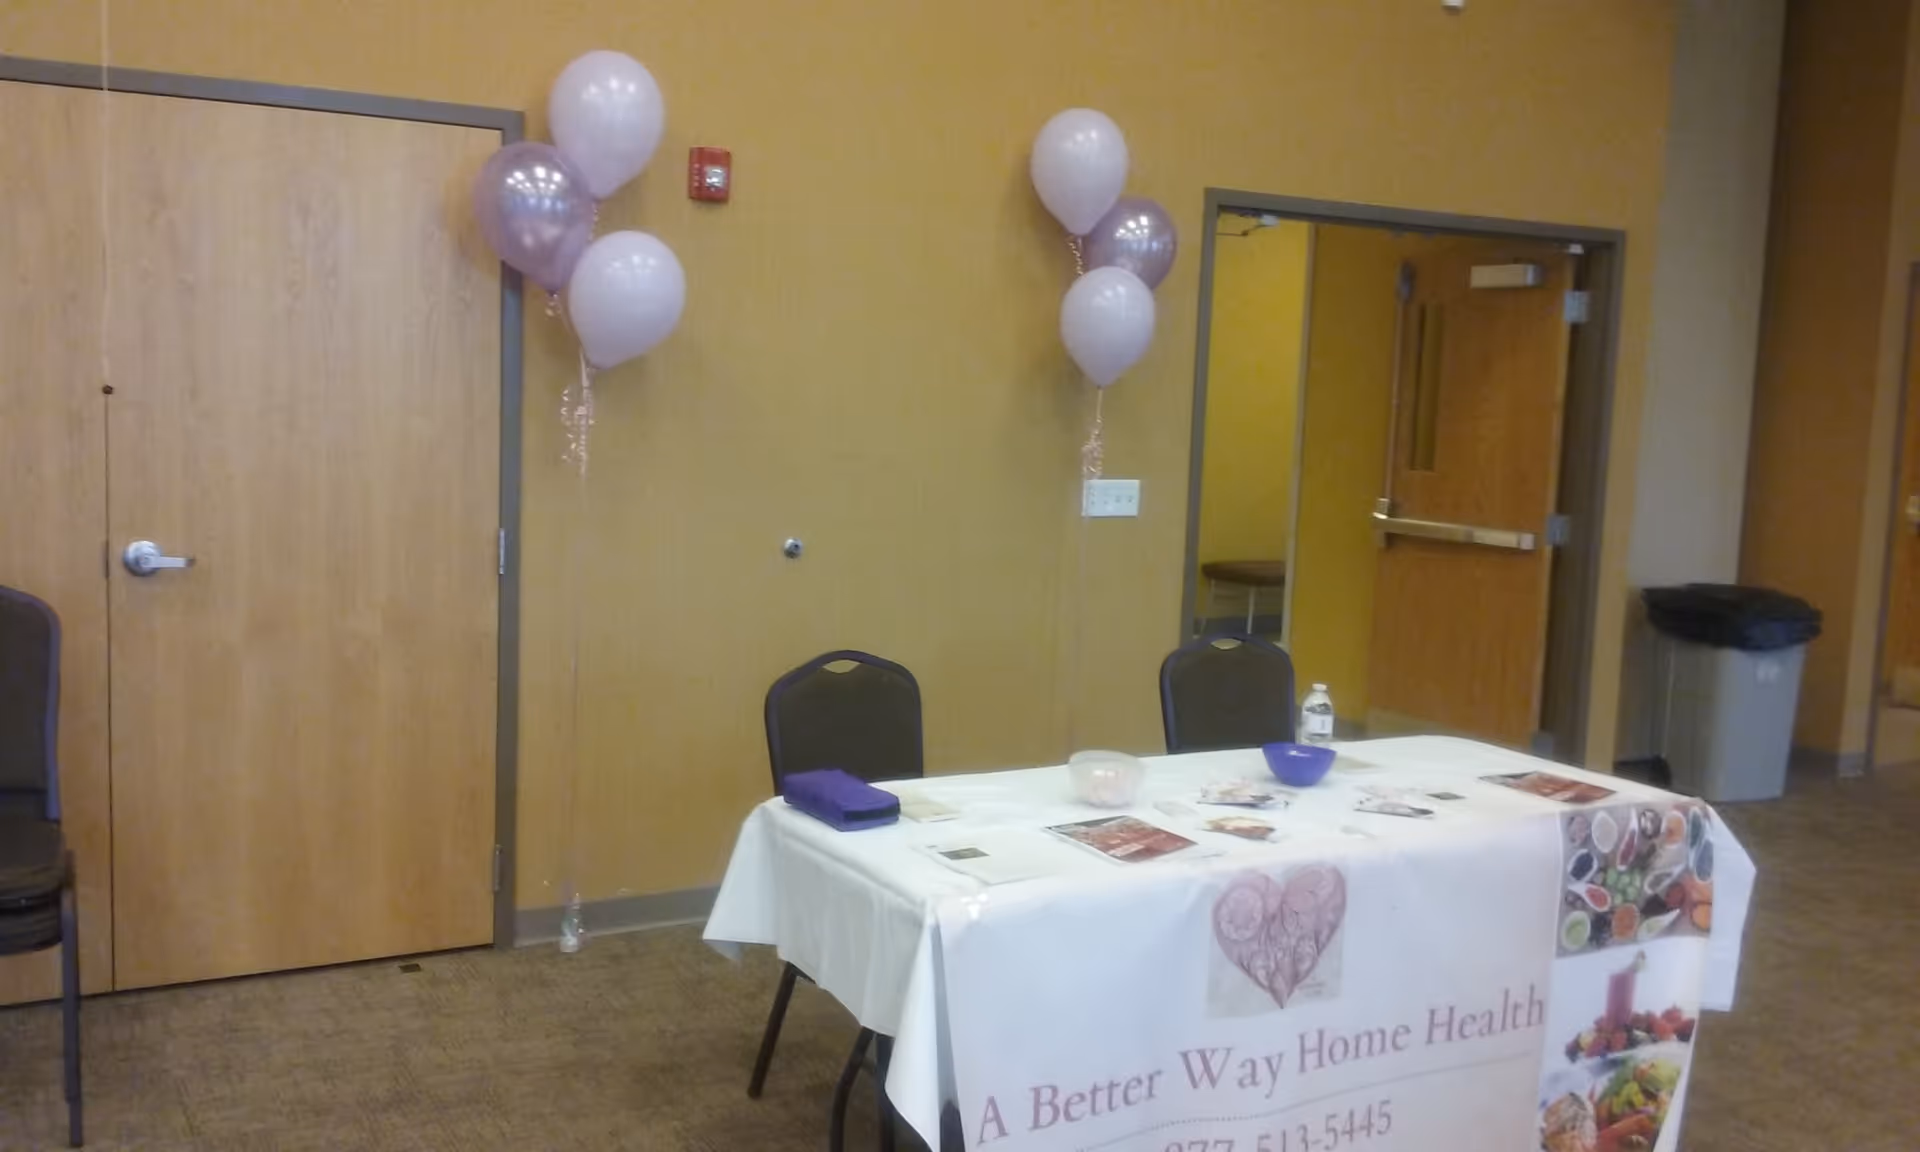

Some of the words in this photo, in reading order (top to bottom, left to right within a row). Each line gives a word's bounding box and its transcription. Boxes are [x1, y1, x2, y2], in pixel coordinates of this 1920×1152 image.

[977, 1095, 1009, 1147] A
[1028, 1070, 1162, 1131] Better
[1179, 1047, 1284, 1099] Way
[1297, 1023, 1411, 1074] Home
[1424, 983, 1544, 1045] Health
